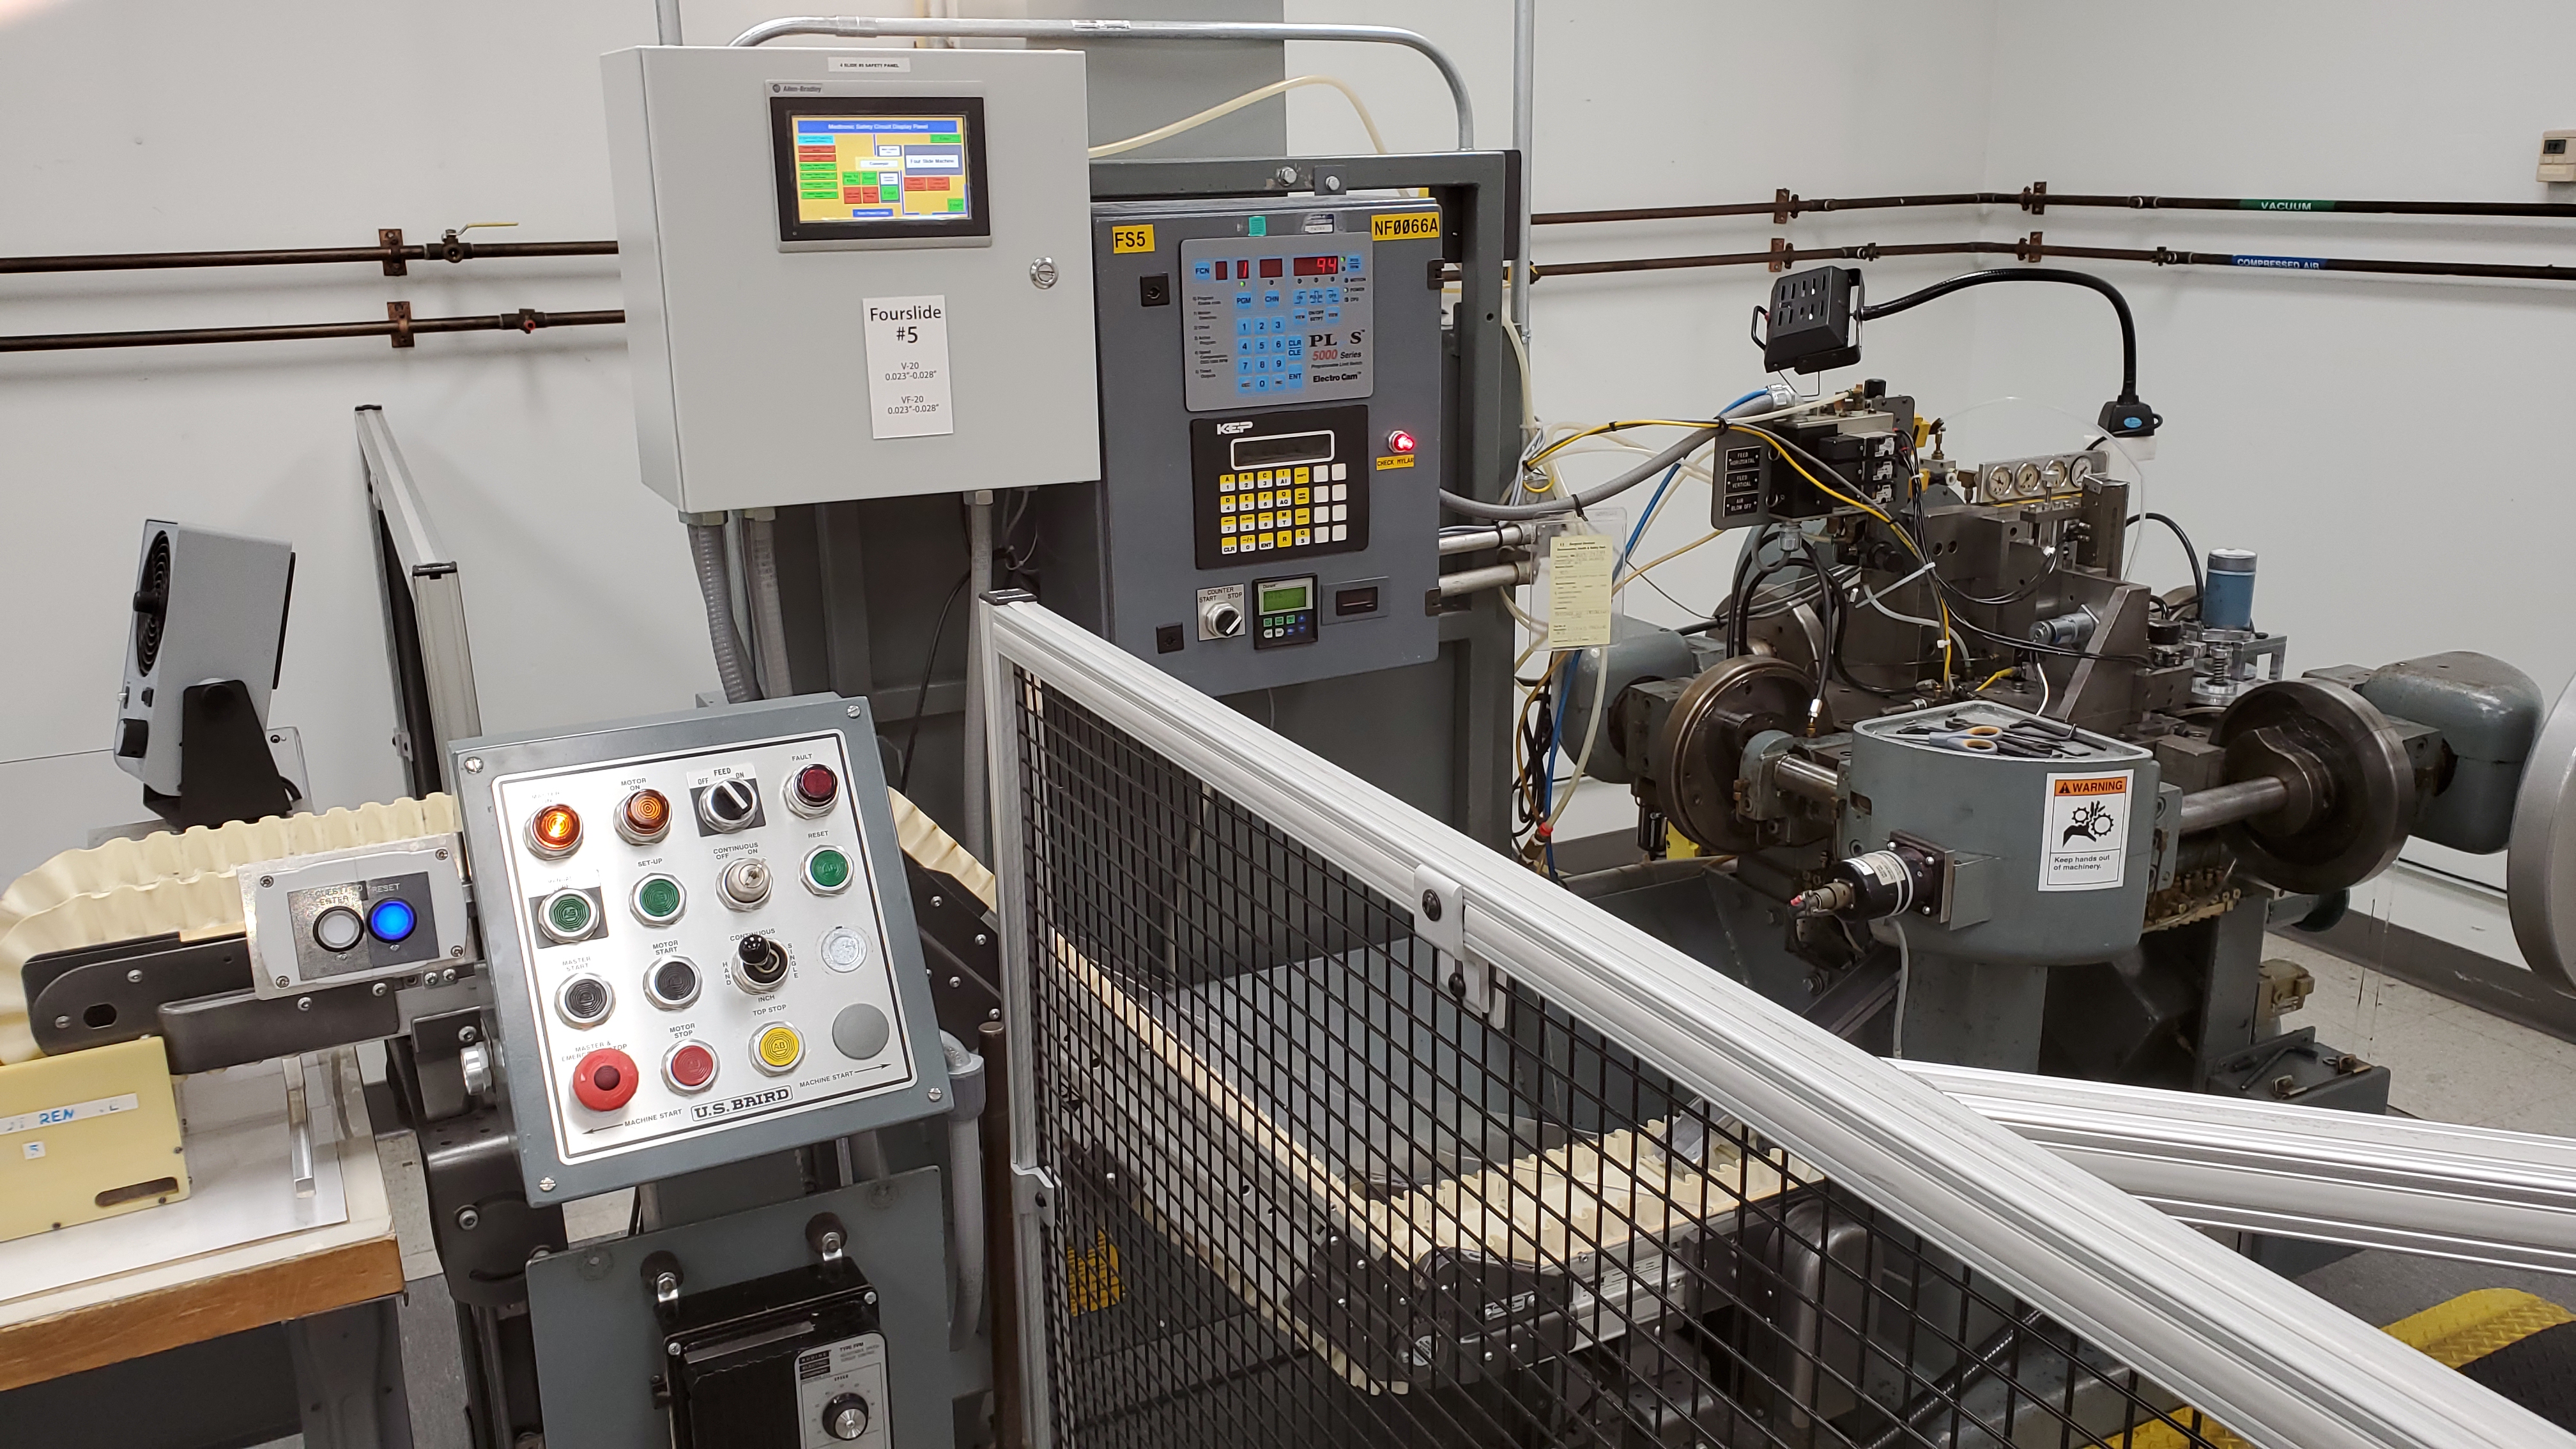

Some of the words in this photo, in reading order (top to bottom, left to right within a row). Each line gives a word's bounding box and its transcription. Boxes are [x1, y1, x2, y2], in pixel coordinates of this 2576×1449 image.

[2260, 201, 2312, 211] VACUUM
[1114, 231, 1146, 249] FS5
[1317, 257, 1337, 273] 94
[2237, 258, 2300, 270] COMPRESSED
[2303, 261, 2320, 270] AIR
[870, 304, 942, 322] Fourslide
[1242, 323, 1246, 331] 1
[1275, 321, 1280, 329] 3
[896, 326, 919, 344] #5
[1312, 349, 1338, 361] 5000
[1340, 351, 1362, 359] Series
[900, 362, 919, 371] V-20
[1243, 362, 1248, 370] 7
[901, 395, 924, 404] VF-20
[1216, 421, 1254, 435] KEP
[1729, 457, 1756, 466] HORIZONTAL
[1207, 586, 1234, 595] COUNTER
[1199, 595, 1217, 603] START
[792, 753, 813, 762] FAULT
[713, 767, 732, 777] FEED
[621, 778, 647, 786] MOTOR
[697, 777, 709, 785] OFF
[735, 771, 745, 779] ON
[2072, 780, 2123, 793] WARNING
[808, 830, 829, 839] RESET
[712, 842, 759, 855] CONTINUOUS
[638, 858, 663, 867] SET-UP
[2054, 856, 2073, 864] Keep
[2074, 855, 2097, 863] hands
[2053, 863, 2062, 871] of
[2062, 863, 2102, 871] machinery.
[372, 882, 401, 893] RESET
[652, 940, 678, 950] MOTOR
[655, 946, 678, 956] START
[562, 956, 592, 967] MASTER
[787, 942, 799, 979] SINGLE
[566, 963, 589, 972] START
[722, 961, 732, 986] HAND
[758, 994, 776, 1003] INCH
[752, 1008, 767, 1016] TOP
[767, 1004, 787, 1013] STOP
[669, 1022, 696, 1033] MOTOR
[673, 1030, 694, 1039] STOP
[575, 1041, 605, 1053] MASTER
[773, 1041, 786, 1051] AB
[799, 1075, 831, 1088] MACHINE
[832, 1070, 854, 1080] START
[694, 1101, 730, 1119] U.S.
[730, 1088, 790, 1111] BAIRD
[624, 1114, 658, 1128] MACHINE
[659, 1108, 683, 1119] START
